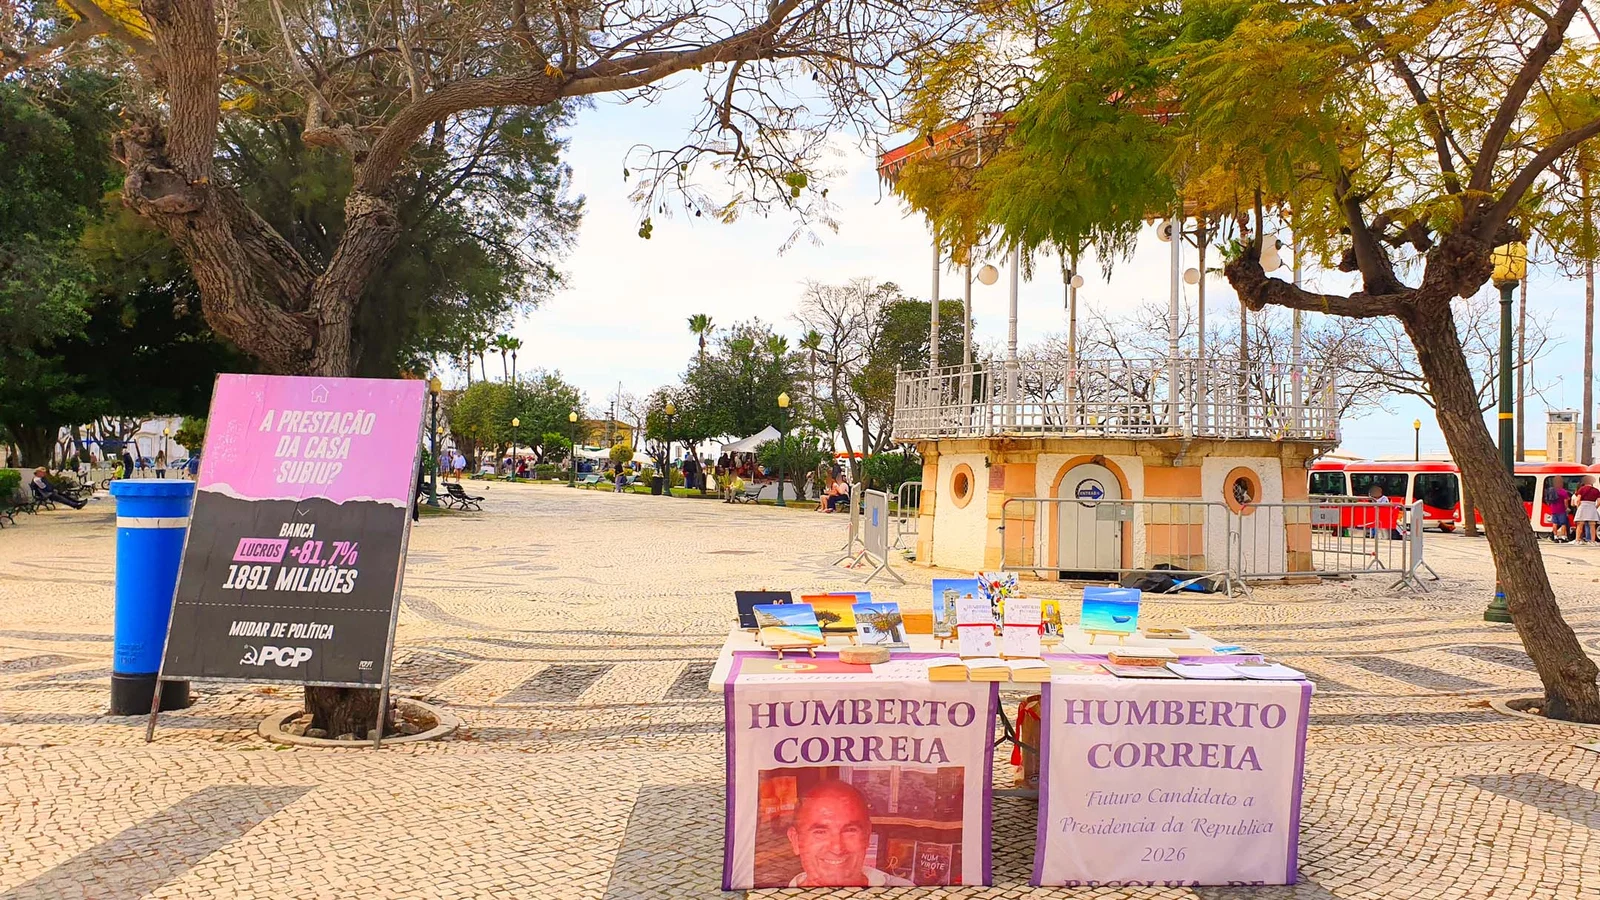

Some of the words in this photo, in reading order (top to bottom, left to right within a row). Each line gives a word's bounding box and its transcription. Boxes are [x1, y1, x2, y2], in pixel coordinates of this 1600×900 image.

[259, 411, 275, 432] A
[276, 409, 376, 437] PRESTAÇÃO
[274, 437, 302, 458] DA
[303, 439, 351, 460] CASA
[276, 462, 343, 485] SUBIU?
[279, 522, 316, 539] BANCA
[239, 541, 283, 558] LUCROS
[289, 540, 359, 567] +81,7%
[222, 564, 271, 590] 1891
[274, 564, 359, 594] MILHÕES
[228, 620, 269, 638] MUDAR
[271, 622, 287, 638] DE
[287, 622, 335, 640] POLÍTICA
[256, 645, 313, 668] PCP
[748, 698, 976, 729] HUMBERTO
[1063, 698, 1287, 729] HUMBERTO
[773, 735, 950, 764] CORREIA
[1087, 742, 1263, 771] CORREIA
[1085, 789, 1142, 807] Futuro
[1148, 787, 1238, 806] Candidato
[1243, 795, 1255, 807] a
[1060, 816, 1156, 835] Presidencia
[1162, 816, 1184, 833] da
[1191, 817, 1274, 839] Republica
[920, 861, 946, 870] VIROTE
[921, 853, 939, 861] NUM
[1141, 846, 1188, 862] 2026
